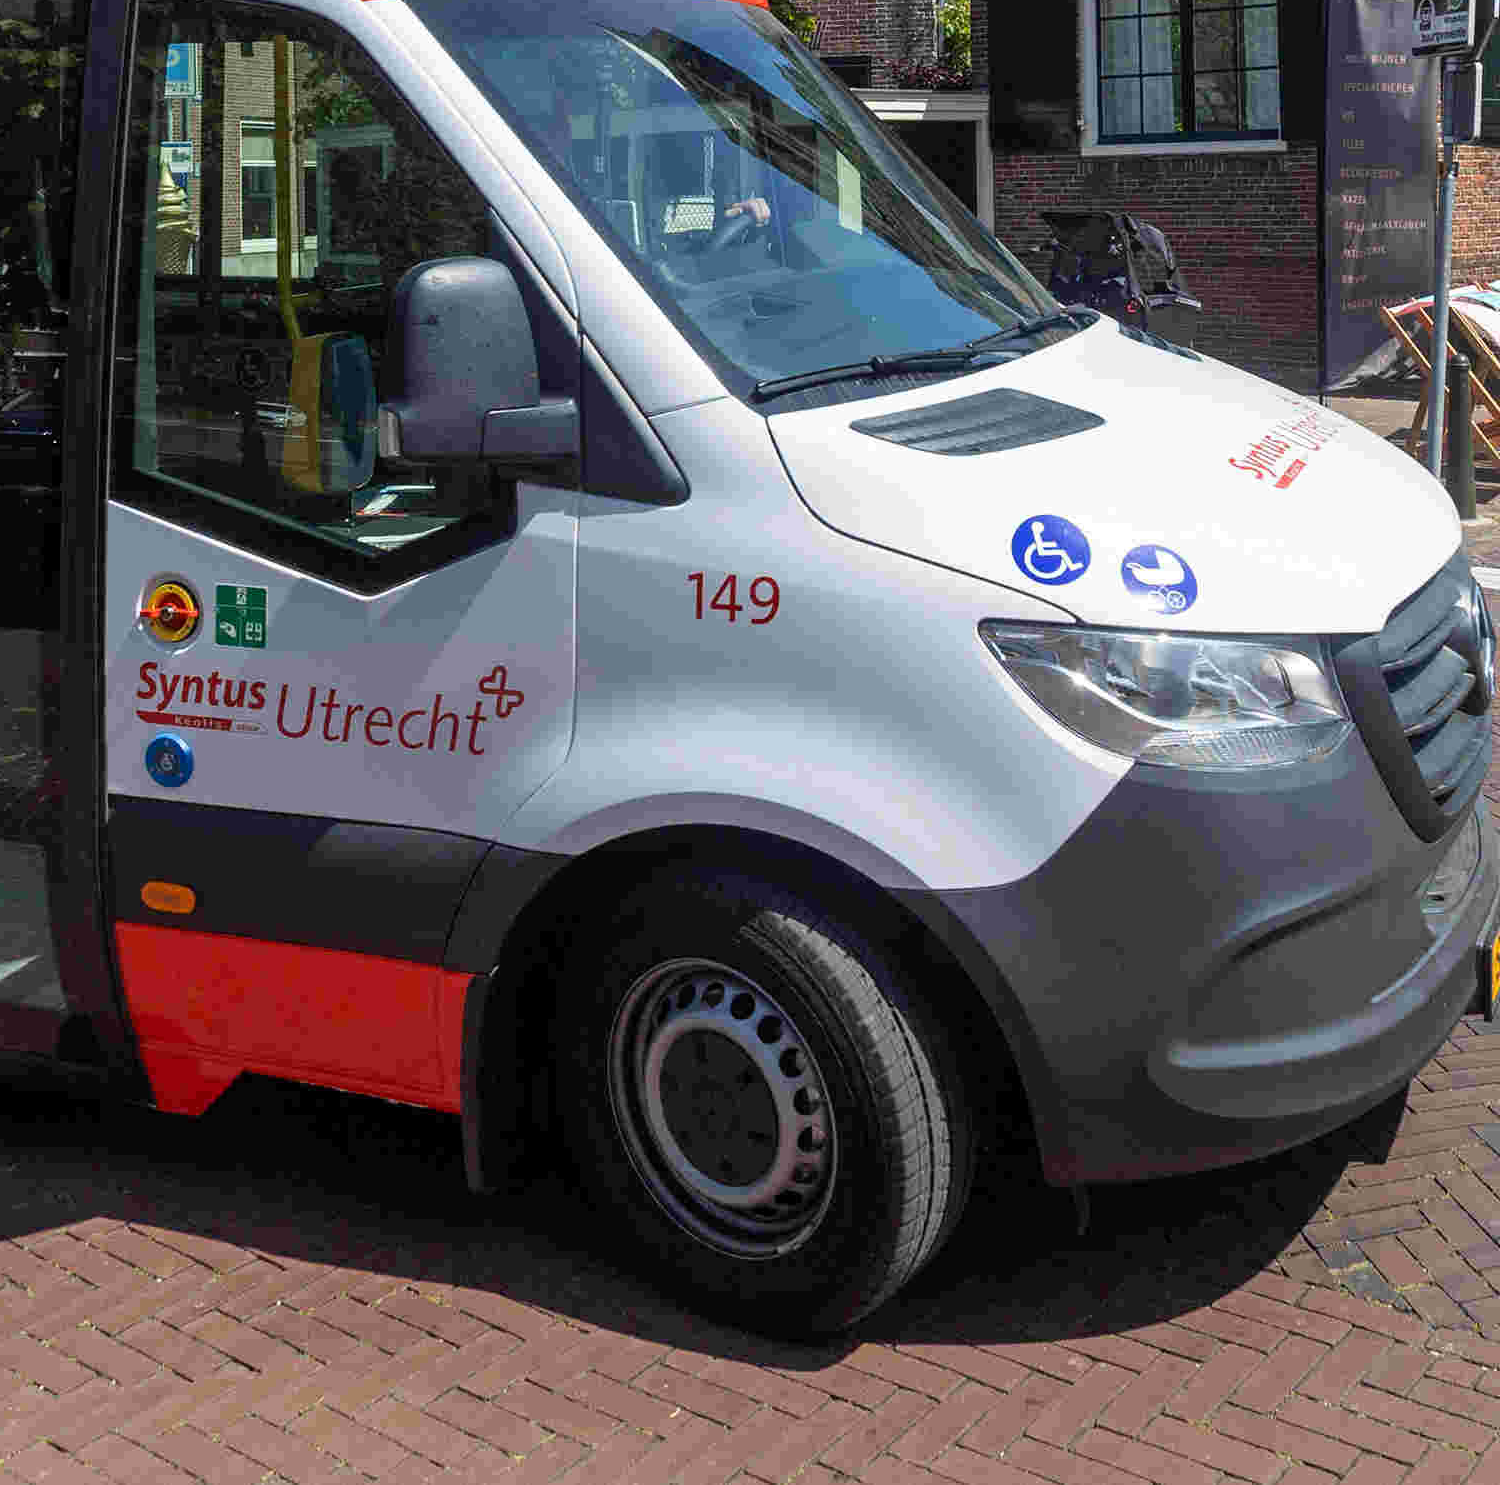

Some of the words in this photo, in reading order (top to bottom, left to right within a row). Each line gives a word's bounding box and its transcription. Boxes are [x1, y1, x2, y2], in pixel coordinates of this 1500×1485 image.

[688, 570, 781, 626] 149
[136, 661, 267, 711] Syntus
[275, 682, 488, 756] Utrecht
